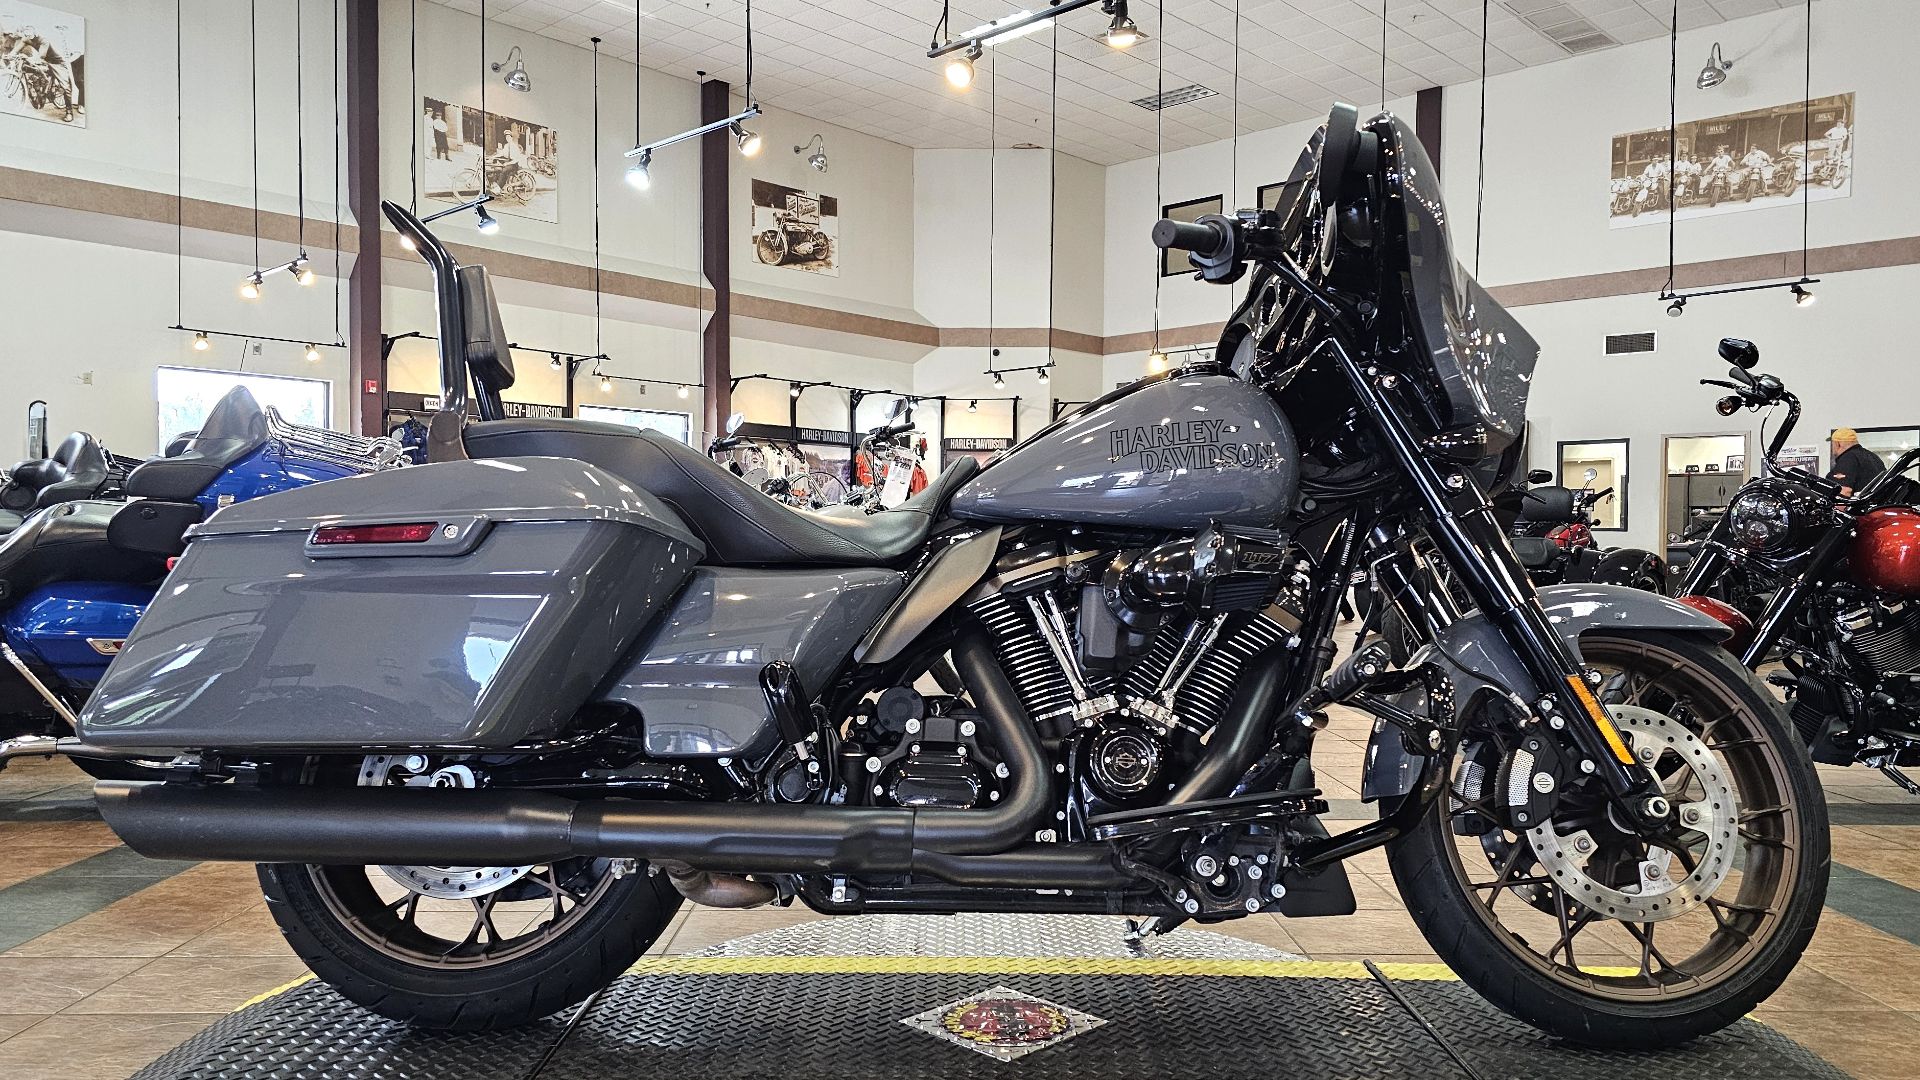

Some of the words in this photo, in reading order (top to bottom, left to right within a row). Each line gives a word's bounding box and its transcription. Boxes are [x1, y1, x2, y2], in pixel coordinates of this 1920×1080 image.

[502, 403, 562, 418] RLEY-DAVIDSON
[801, 429, 848, 443] HARLEY-DAVIDSON
[1110, 419, 1240, 463] HARLEY-
[950, 439, 1007, 449] HARLEY-DAVIDSON
[1140, 443, 1273, 474] DAVIDSON
[1242, 551, 1278, 564] 117
